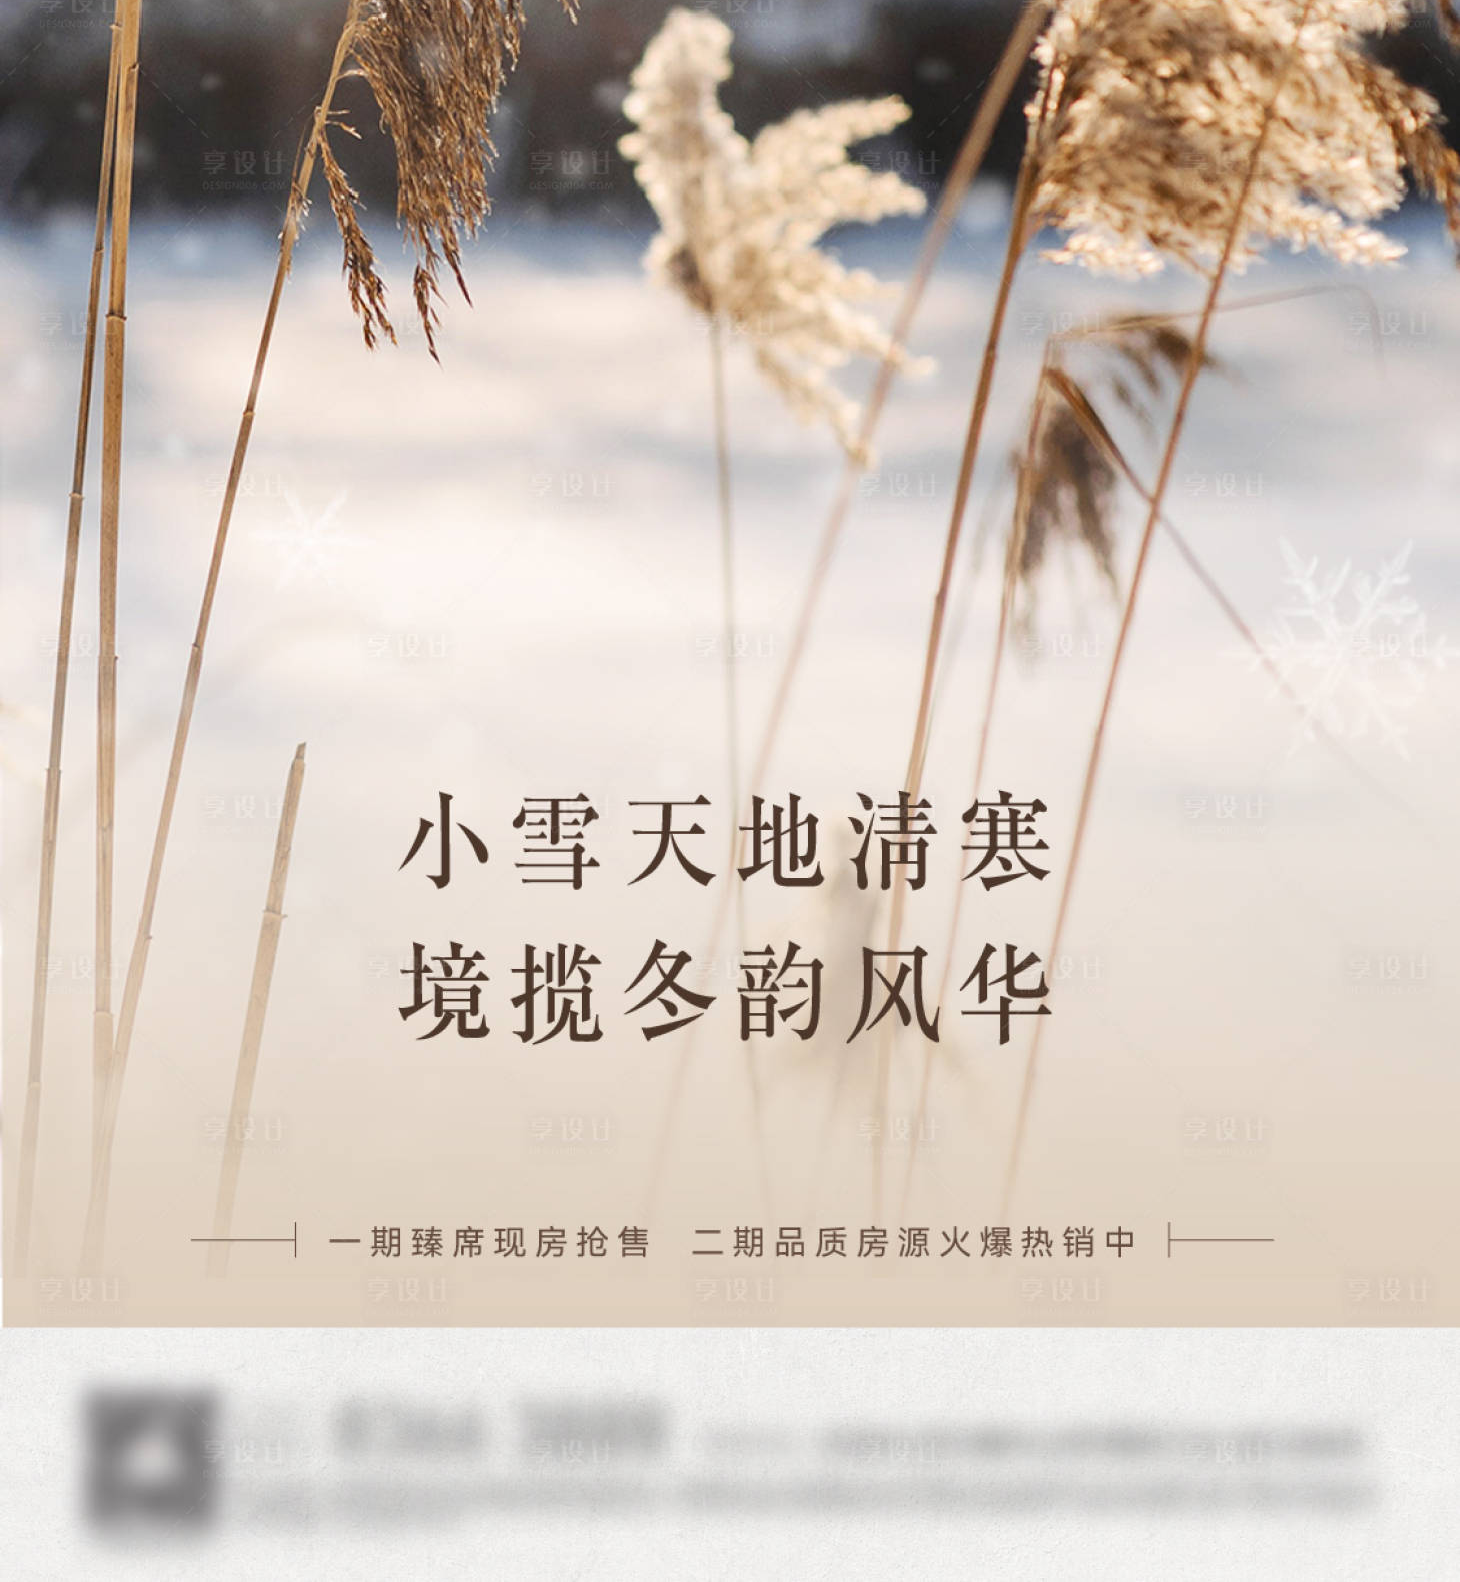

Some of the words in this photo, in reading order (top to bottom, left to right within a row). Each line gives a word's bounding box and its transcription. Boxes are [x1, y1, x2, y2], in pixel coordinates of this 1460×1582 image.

[398, 791, 1052, 892] 小雪天地清寒
[398, 939, 1053, 1046] 境揽冬韵风华
[329, 1225, 651, 1259] 一期臻席现房抢售
[691, 1225, 1135, 1259] 二期品质房源火爆热销中
